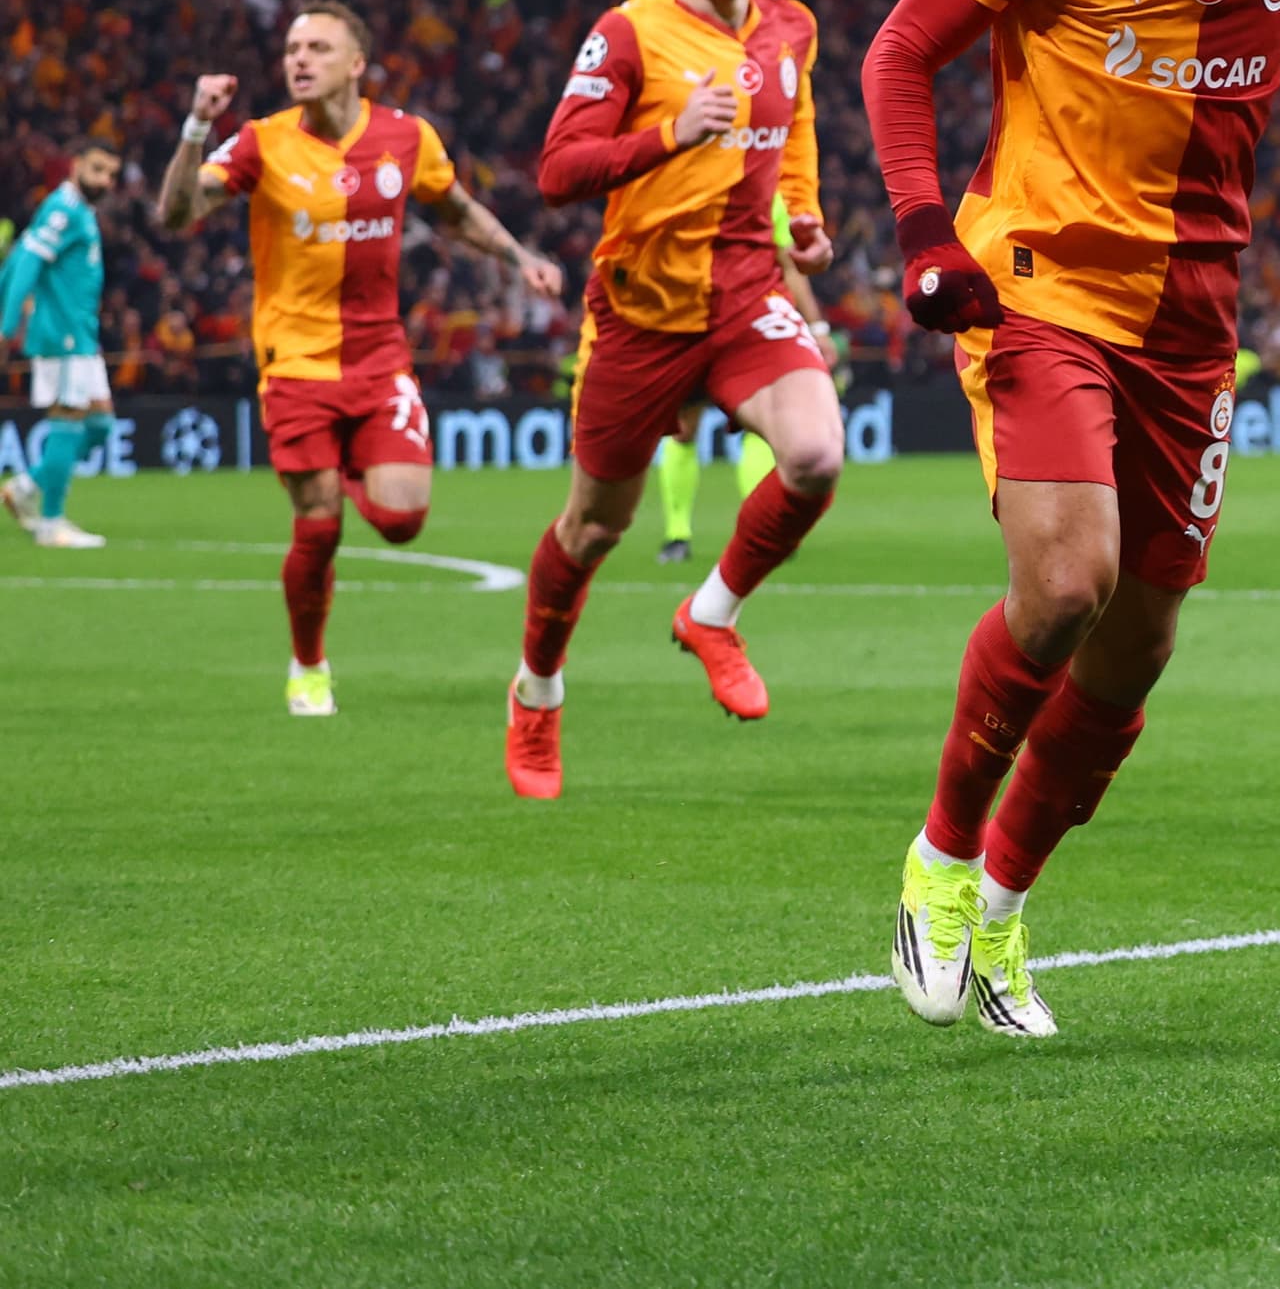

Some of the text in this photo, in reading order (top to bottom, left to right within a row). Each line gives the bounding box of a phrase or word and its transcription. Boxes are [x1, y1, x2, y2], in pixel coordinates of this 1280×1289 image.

[1149, 55, 1266, 91] SOCAR
[317, 216, 395, 243] SOCAR
[1190, 441, 1230, 519] 8
